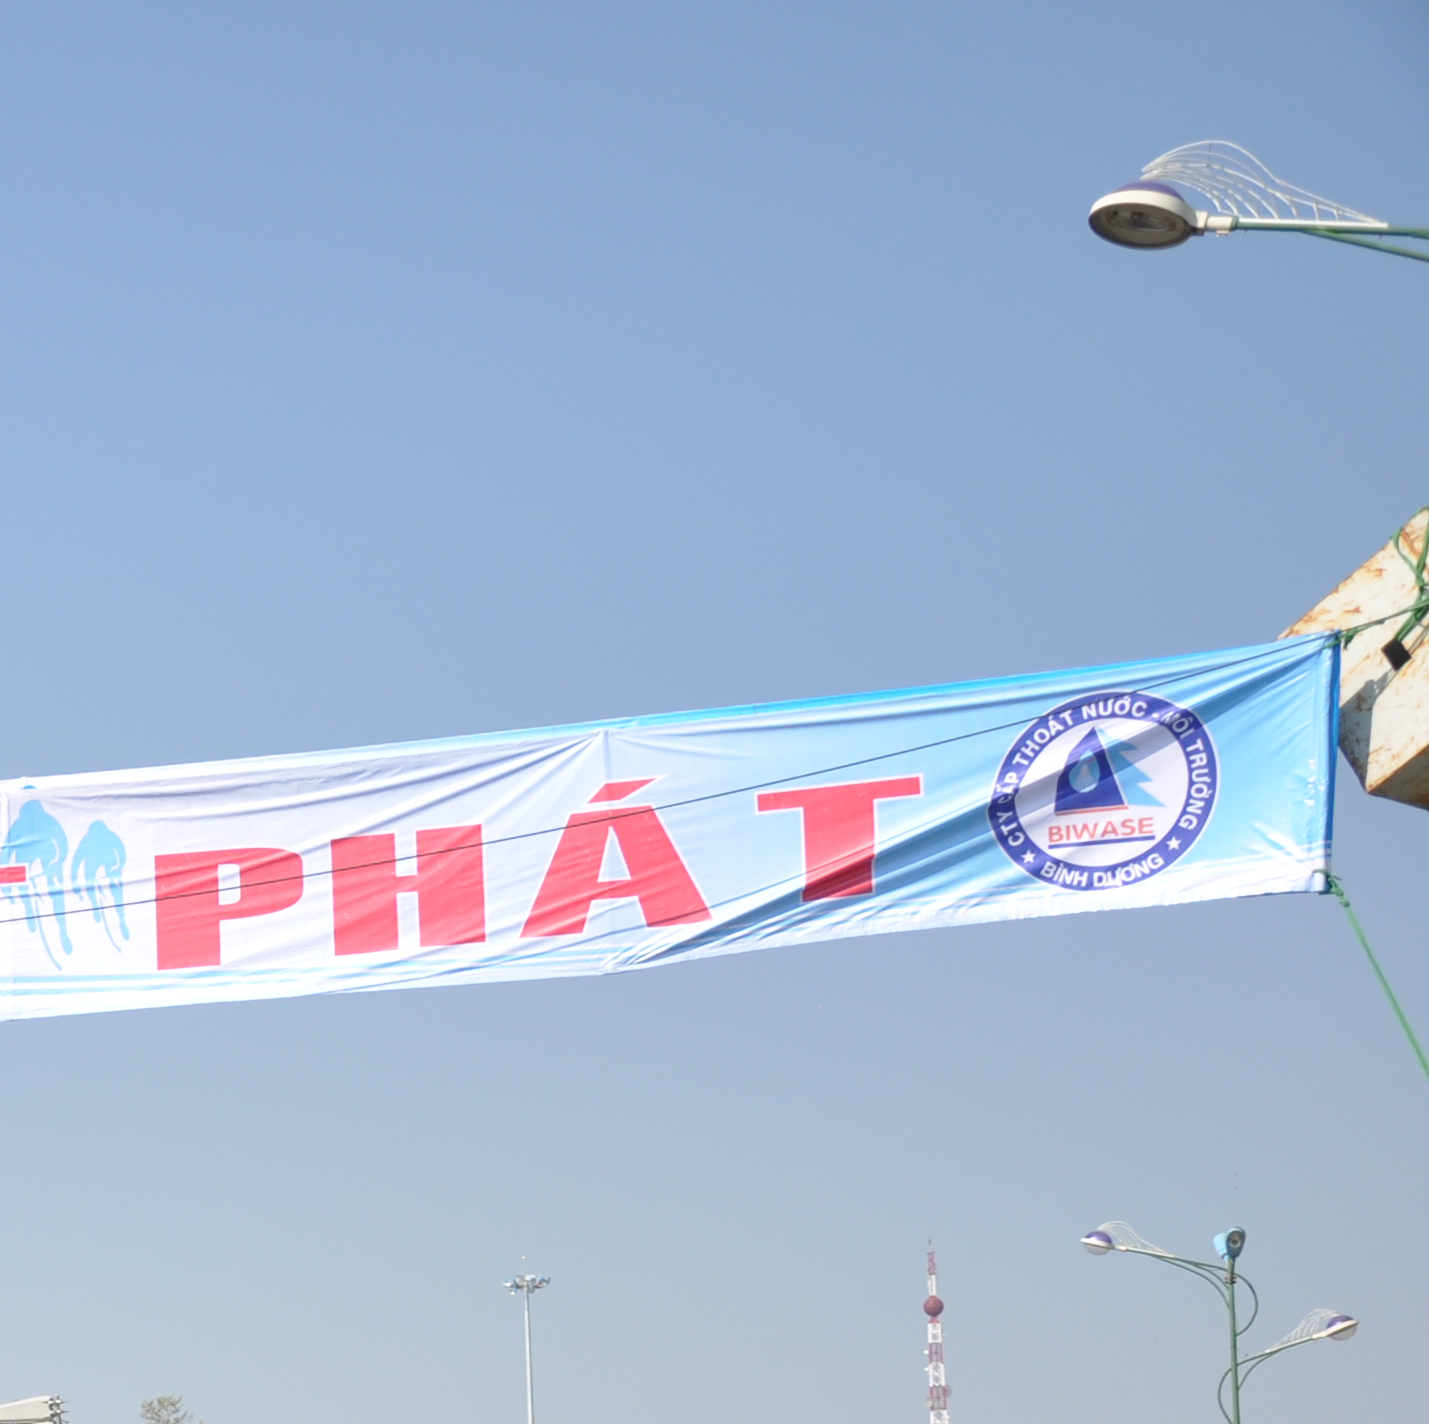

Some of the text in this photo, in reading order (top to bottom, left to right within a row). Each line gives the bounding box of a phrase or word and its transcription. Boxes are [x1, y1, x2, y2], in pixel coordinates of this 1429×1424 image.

[997, 810, 1024, 847] CTY
[1012, 709, 1074, 767] THOÁT
[1081, 696, 1148, 720] NƯỚC
[1178, 738, 1213, 830] TRƯỜNG
[153, 775, 922, 971] PHÁT
[1040, 861, 1089, 887] BÌNH
[1048, 817, 1155, 843] BIWASE
